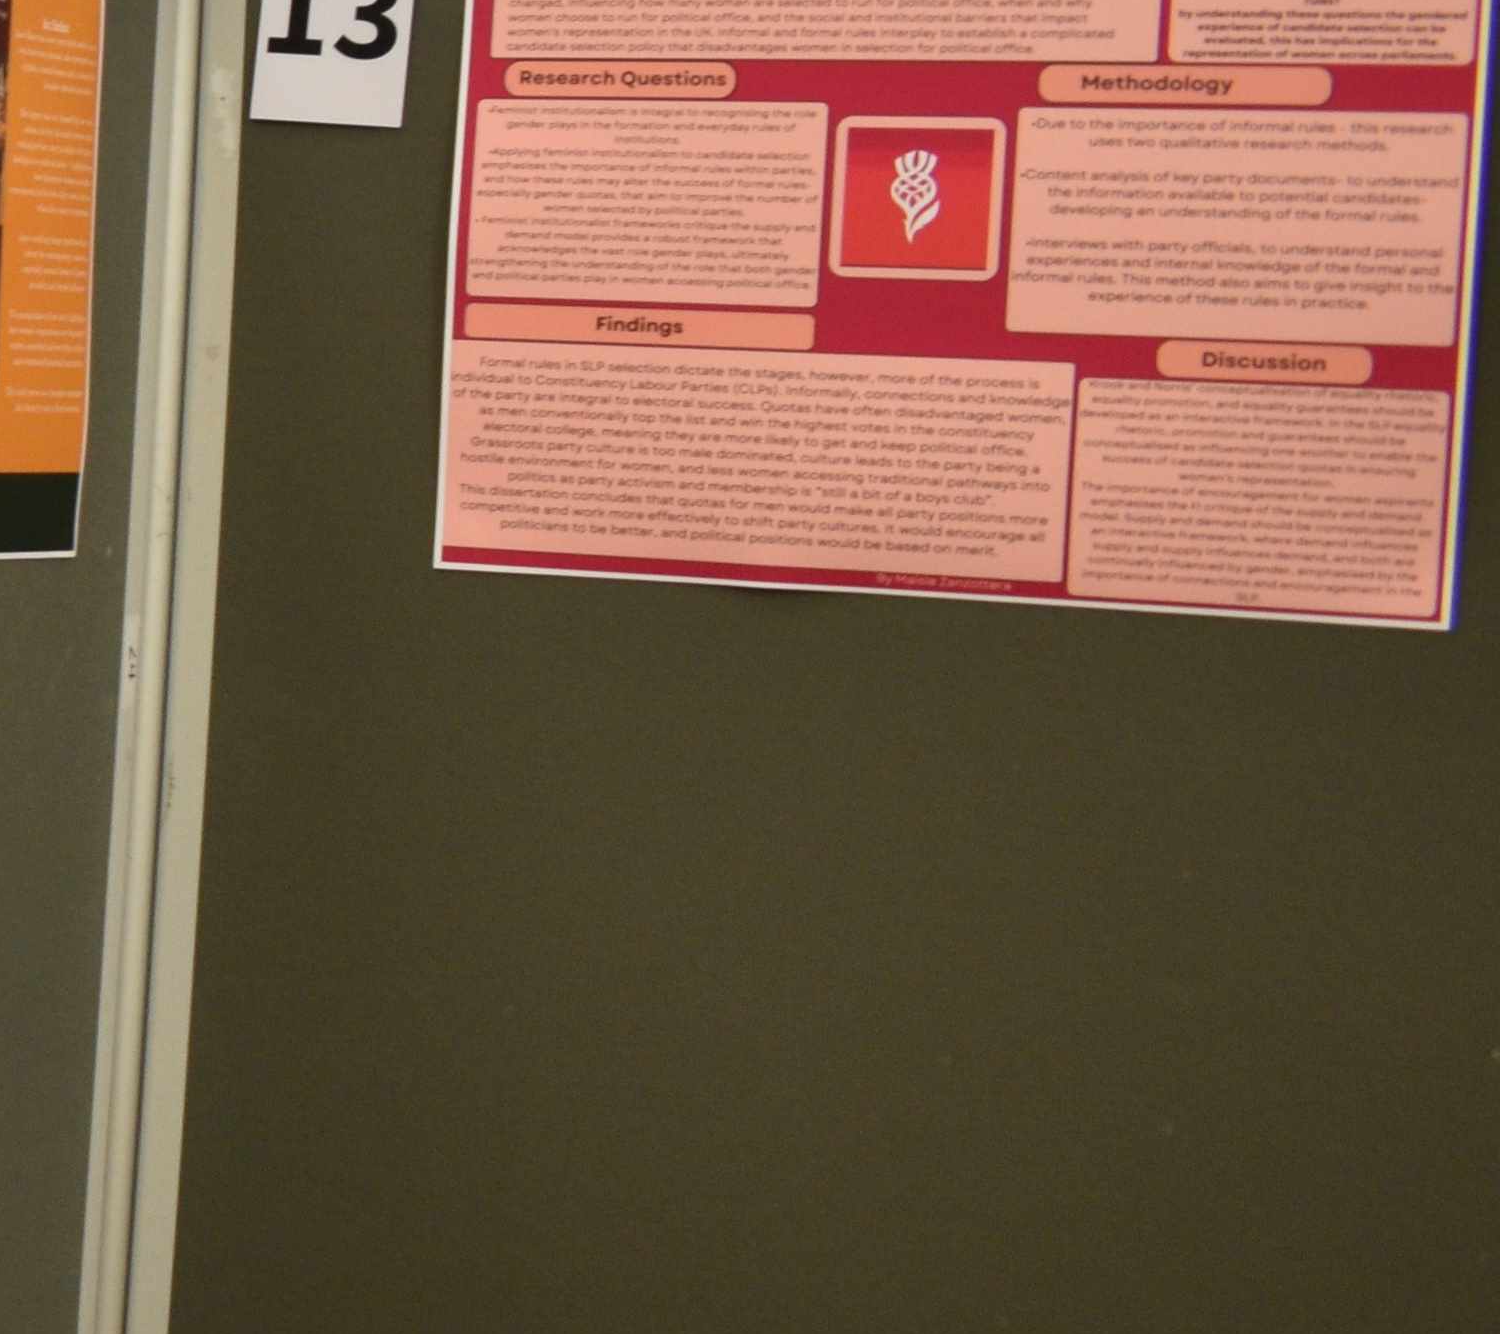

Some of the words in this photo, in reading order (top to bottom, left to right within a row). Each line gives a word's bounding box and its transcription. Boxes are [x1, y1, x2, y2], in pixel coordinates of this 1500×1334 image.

[517, 70, 617, 85] Research
[618, 70, 728, 87] Questions
[1077, 75, 1237, 95] Methodology
[593, 315, 685, 336] Findings
[1198, 351, 1328, 371] Discussion
